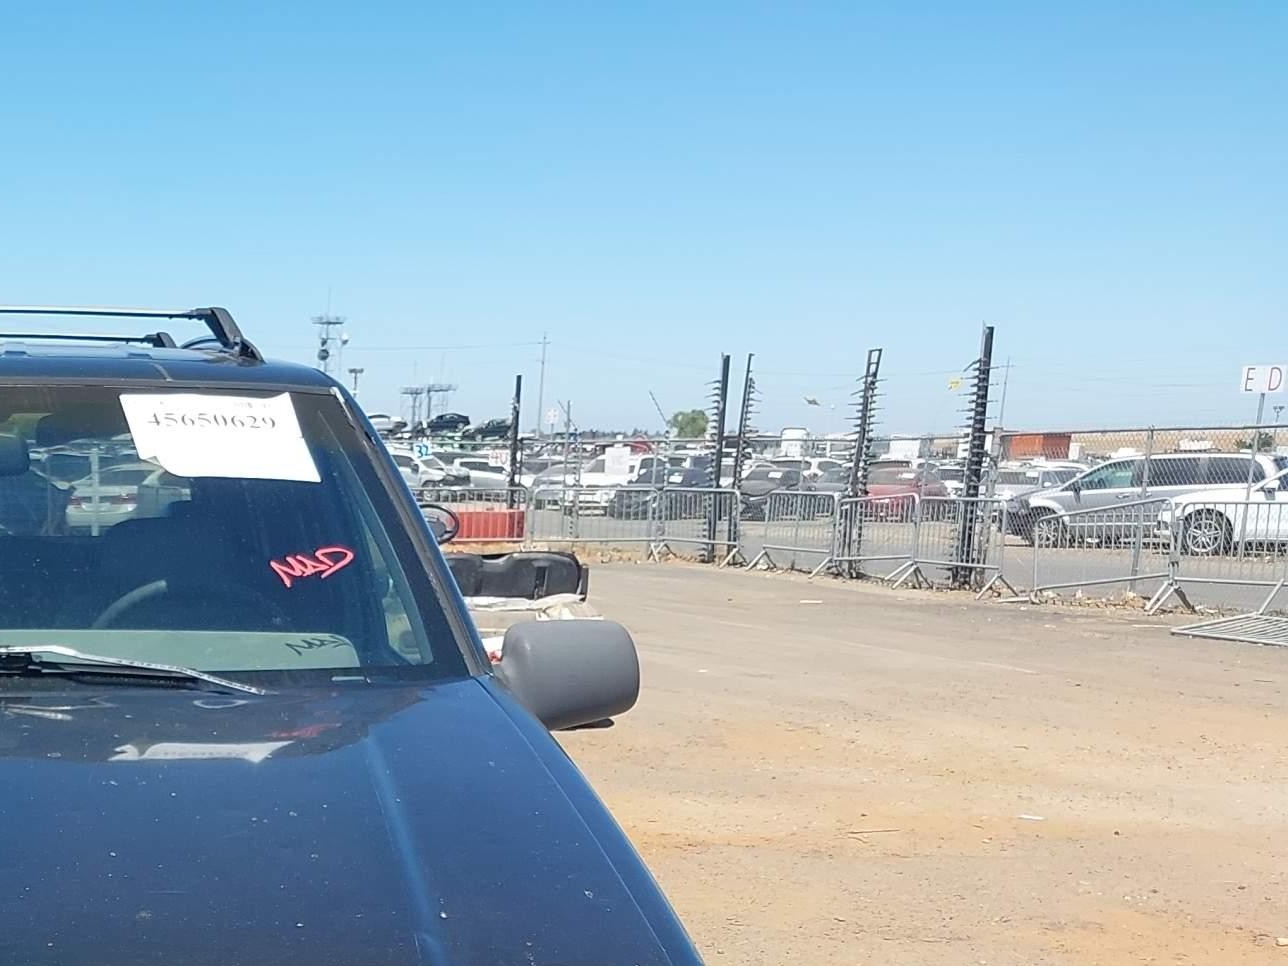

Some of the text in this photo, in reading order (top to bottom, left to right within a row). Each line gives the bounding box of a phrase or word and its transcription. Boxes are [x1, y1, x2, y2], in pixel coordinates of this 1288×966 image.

[1244, 366, 1283, 392] E D
[148, 412, 276, 429] 45650629
